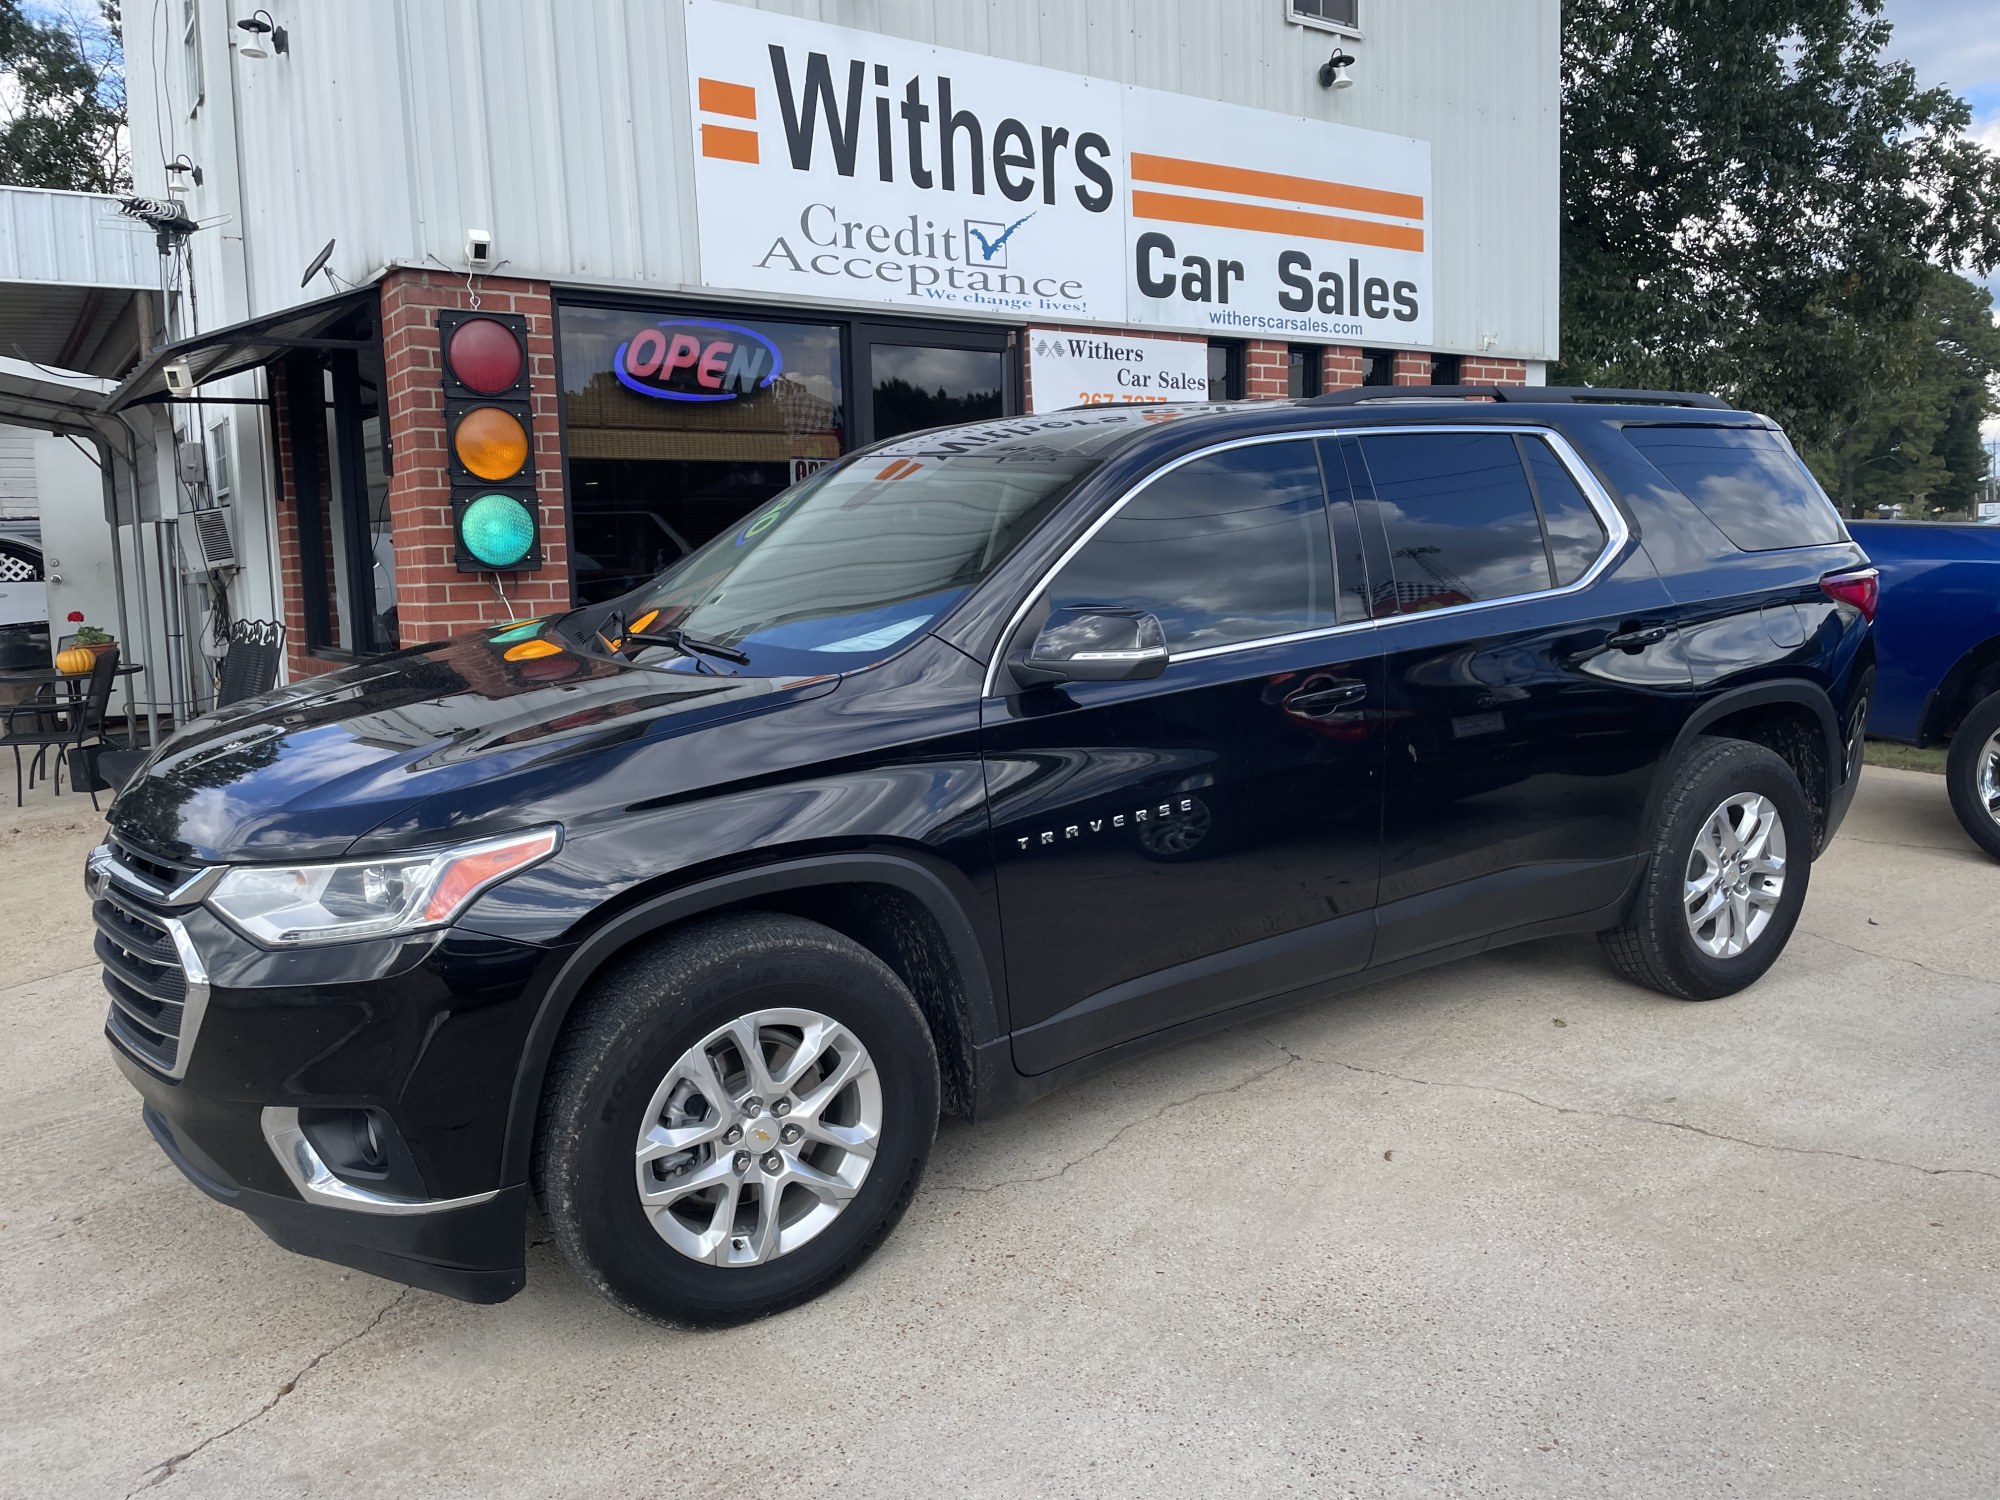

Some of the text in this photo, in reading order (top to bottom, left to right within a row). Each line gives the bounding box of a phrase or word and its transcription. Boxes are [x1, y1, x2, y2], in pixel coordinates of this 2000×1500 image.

[768, 45, 1113, 212] Withers
[800, 203, 959, 262] Credit
[752, 236, 1083, 299] Acceptance
[1136, 232, 1419, 322] Car Sales
[926, 287, 1087, 313] We change lives!
[1209, 310, 1363, 335] witherscarsales.com
[626, 329, 766, 393] OPEN
[1067, 339, 1144, 362] Withers
[1117, 368, 1206, 391] Car Sales
[1017, 799, 1192, 850] TRAVERSE
